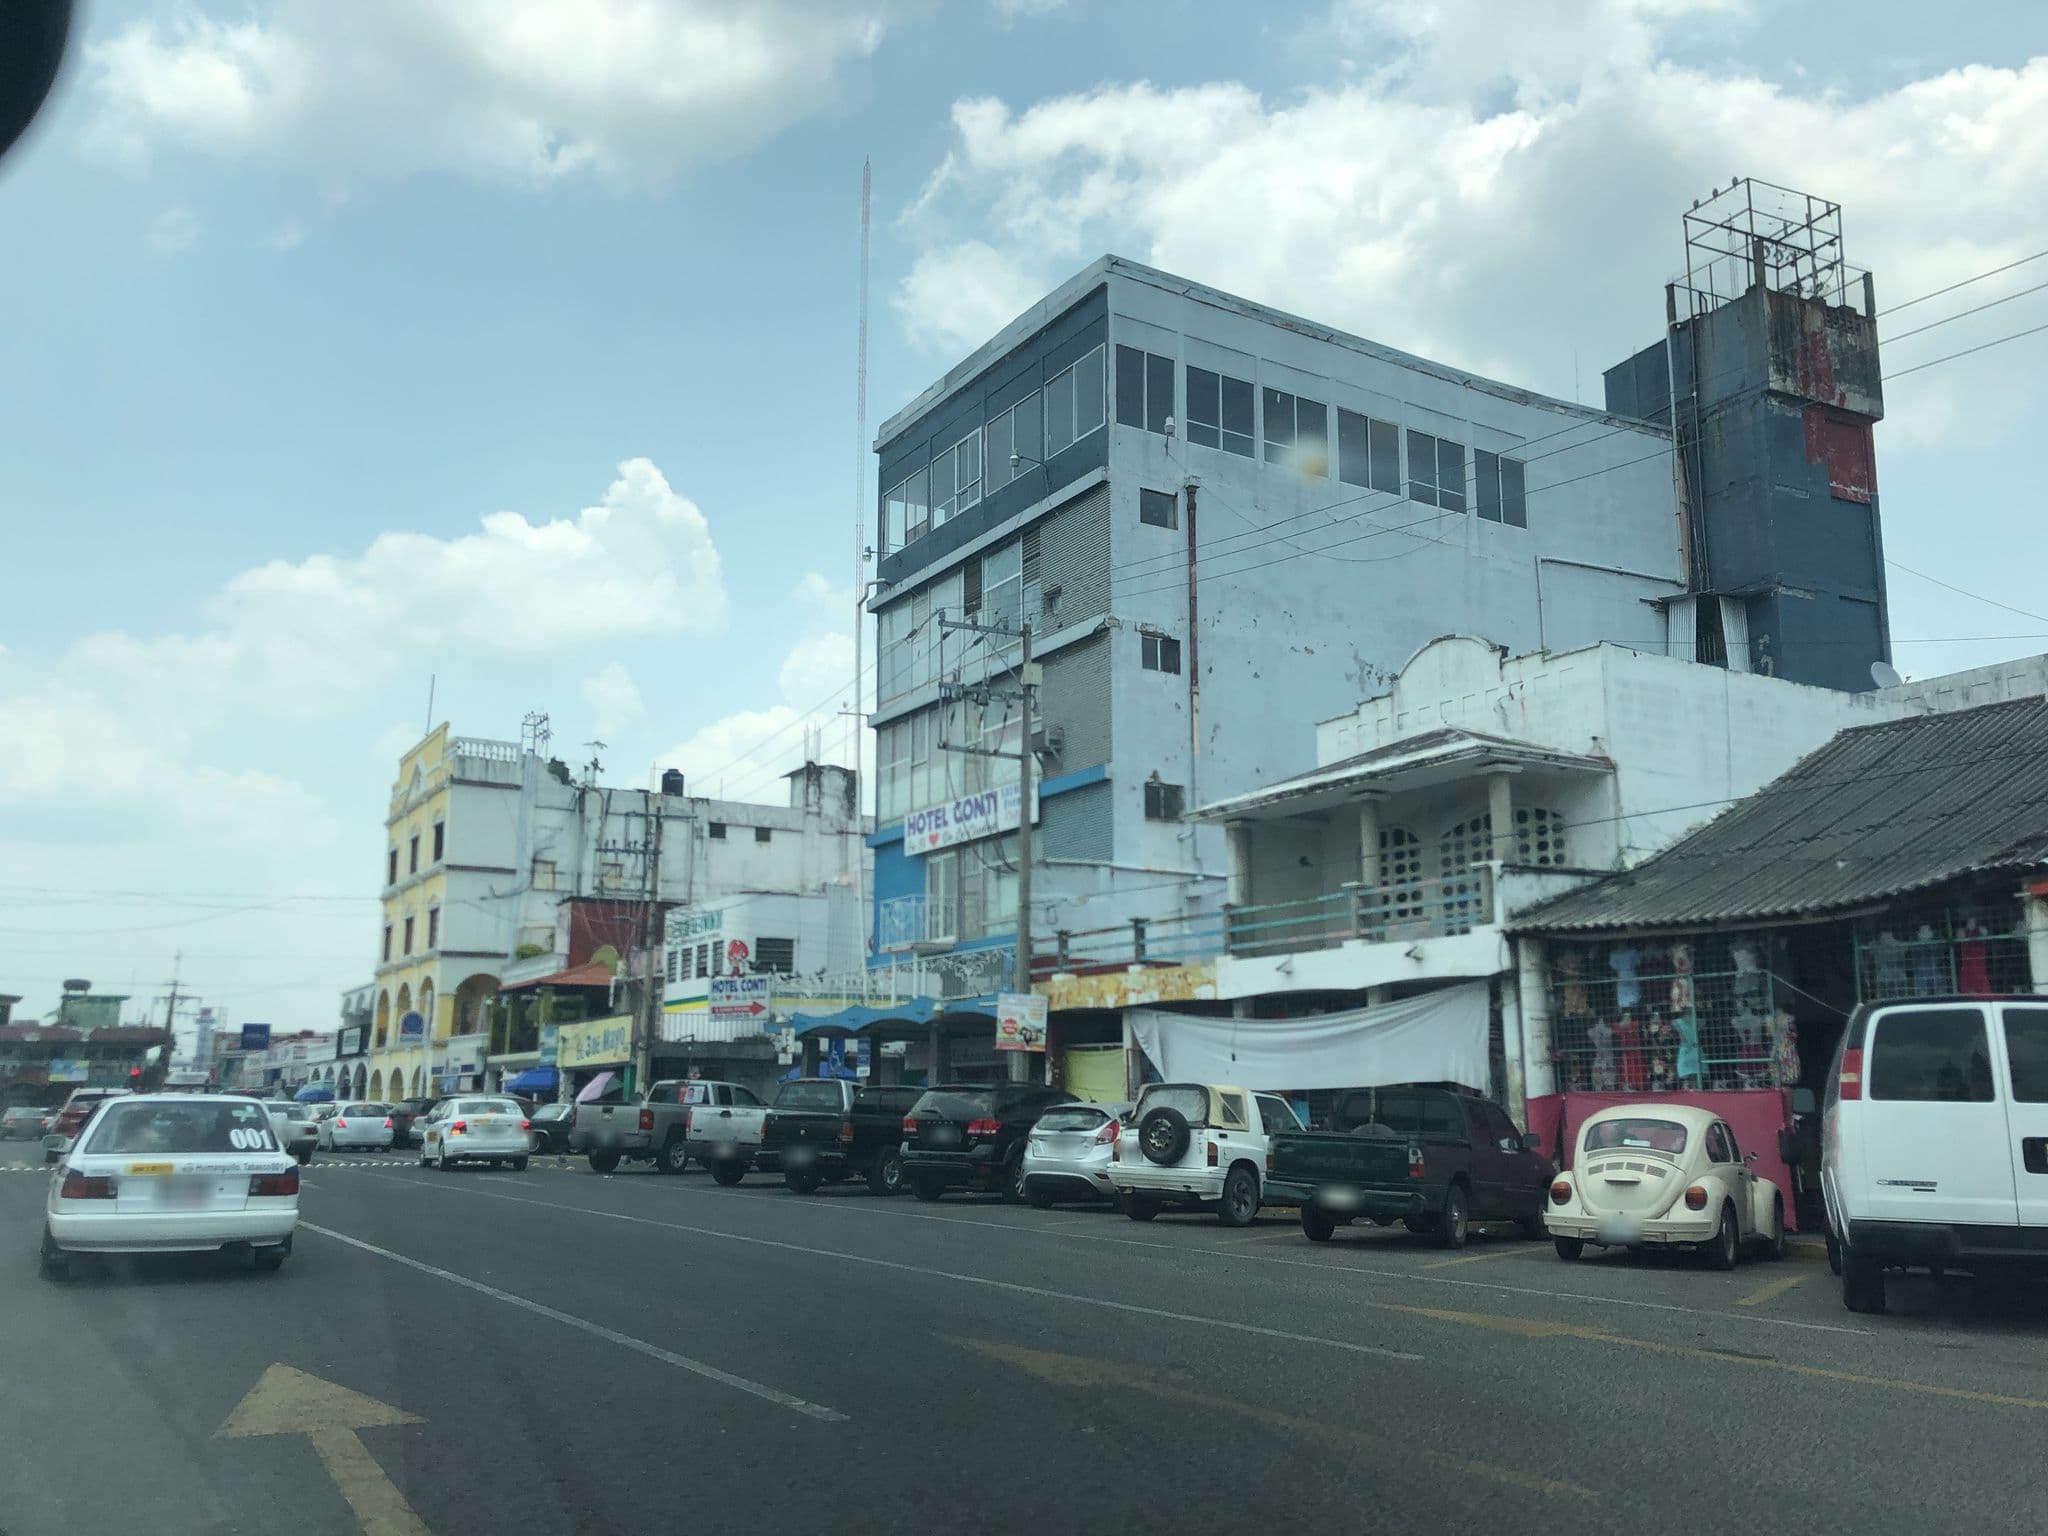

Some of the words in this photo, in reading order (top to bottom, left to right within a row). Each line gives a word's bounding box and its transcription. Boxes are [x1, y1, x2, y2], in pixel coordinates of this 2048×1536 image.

[907, 807, 949, 837] HOTEL
[953, 792, 998, 823] CONTI
[711, 979, 738, 993] HOTEL
[741, 978, 767, 992] CONTI
[230, 1128, 274, 1149] 001
